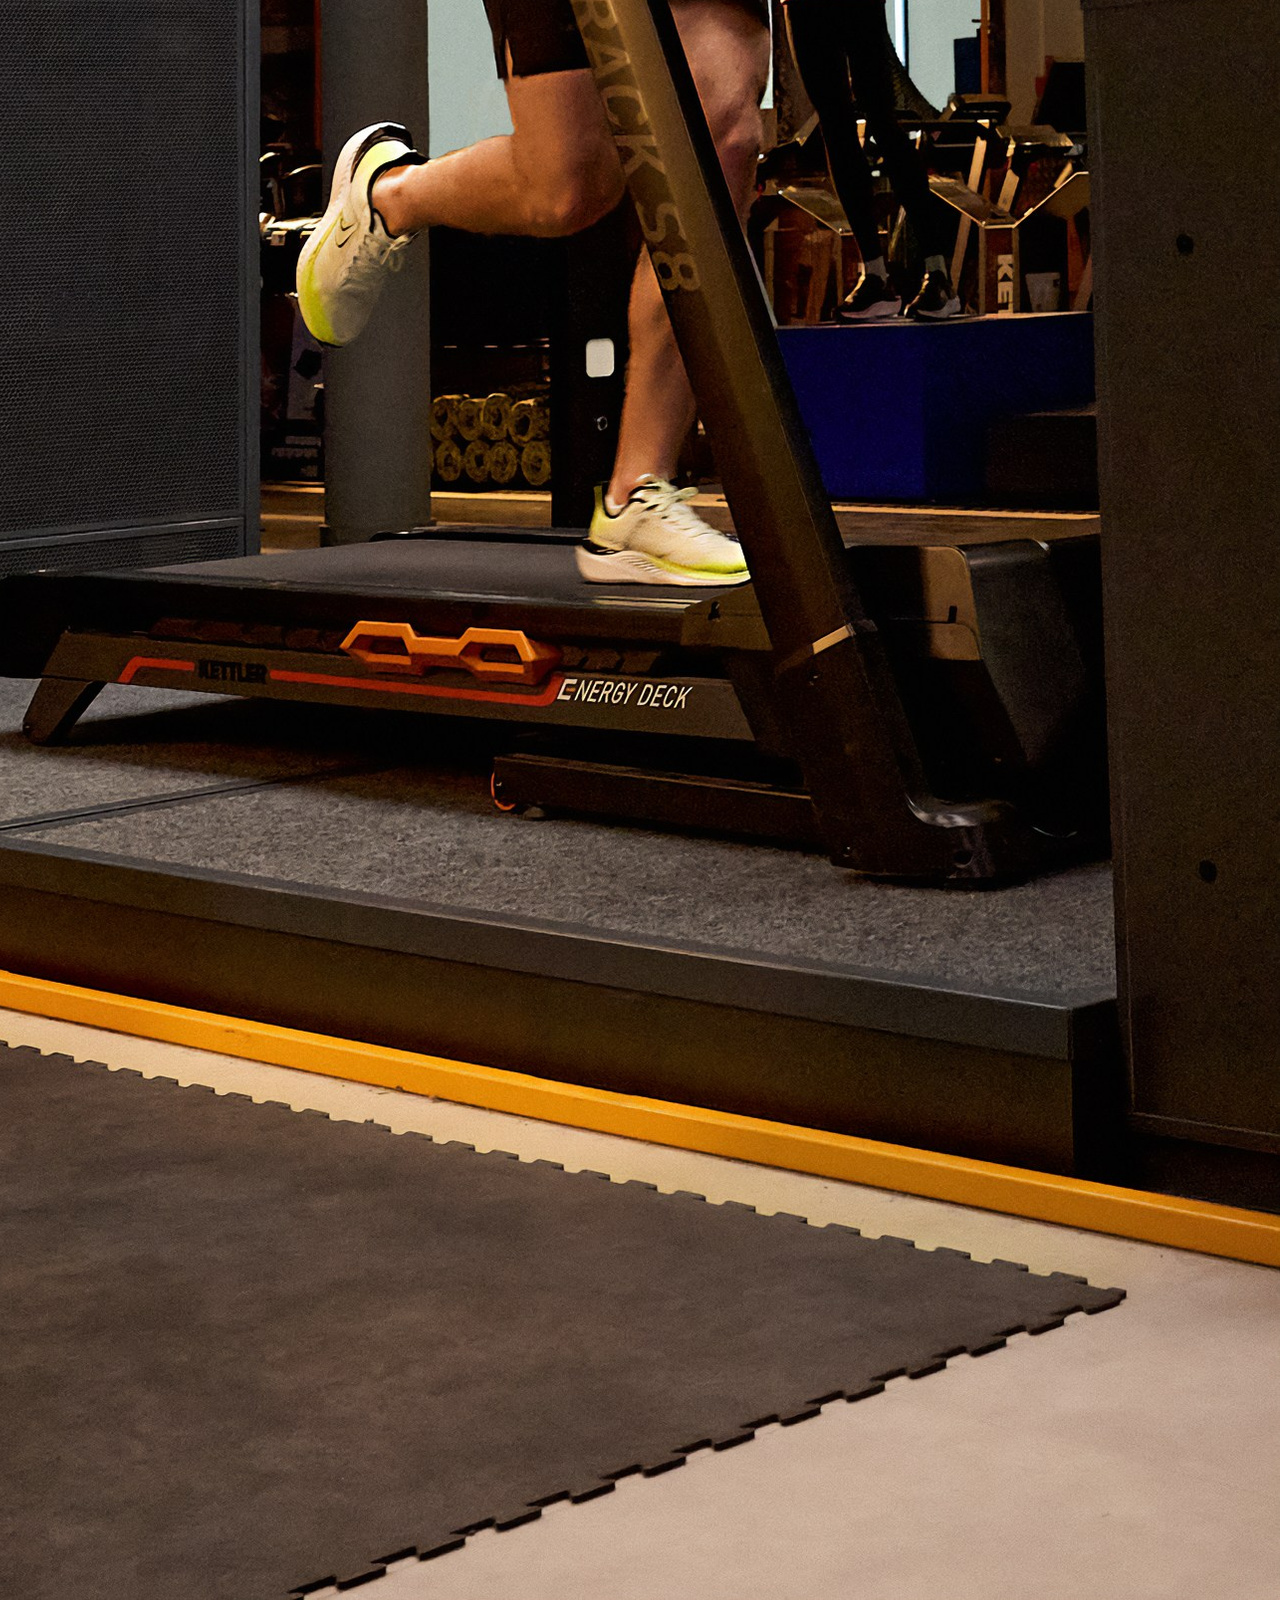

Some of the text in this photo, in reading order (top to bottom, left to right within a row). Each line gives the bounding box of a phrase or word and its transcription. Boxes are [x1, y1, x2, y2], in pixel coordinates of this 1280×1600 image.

[637, 203, 700, 291] S8
[199, 660, 267, 684] KETTLER
[556, 678, 694, 709] ENERGY DECK
